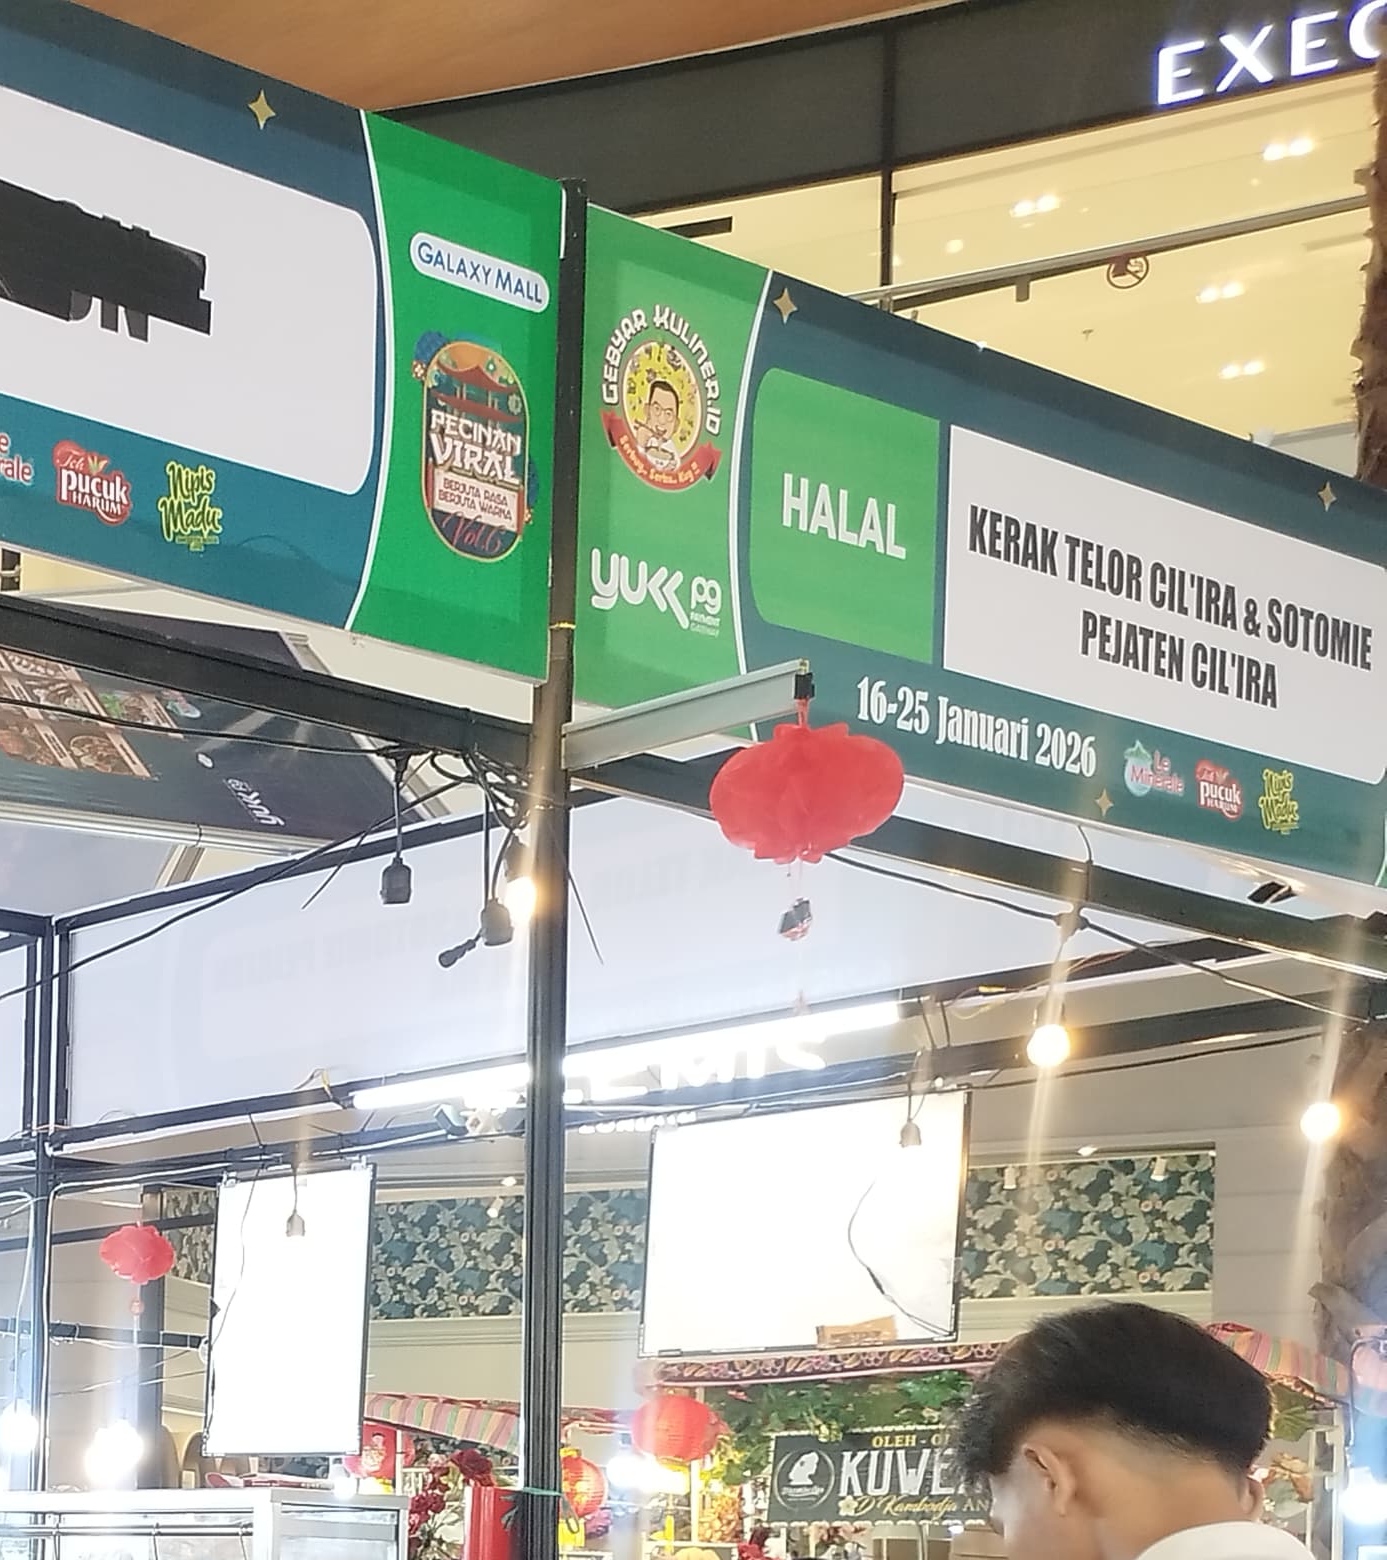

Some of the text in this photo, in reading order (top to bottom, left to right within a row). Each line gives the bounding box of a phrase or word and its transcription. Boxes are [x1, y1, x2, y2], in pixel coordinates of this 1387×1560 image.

[417, 241, 542, 304] GALAXY MALL
[602, 308, 648, 405] GEBYAR
[429, 408, 522, 456] PECINAN
[167, 461, 216, 500] Nipis
[429, 432, 521, 486] VIRAL
[61, 468, 127, 505] pucuk
[72, 490, 123, 517] HARUM
[437, 488, 477, 513] BERJUTA
[442, 476, 482, 500] BERJUTA
[158, 496, 223, 542] Madu
[781, 471, 908, 562] HALAL
[968, 504, 1374, 672] KERAK TELOR CIL'IRA & SOTOMIE
[1080, 609, 1279, 709] PEJATEN CIL'IRA
[856, 674, 1098, 778] 16-25 Januari 2026
[1199, 780, 1242, 806] pucuk
[871, 1433, 917, 1449] OLEH
